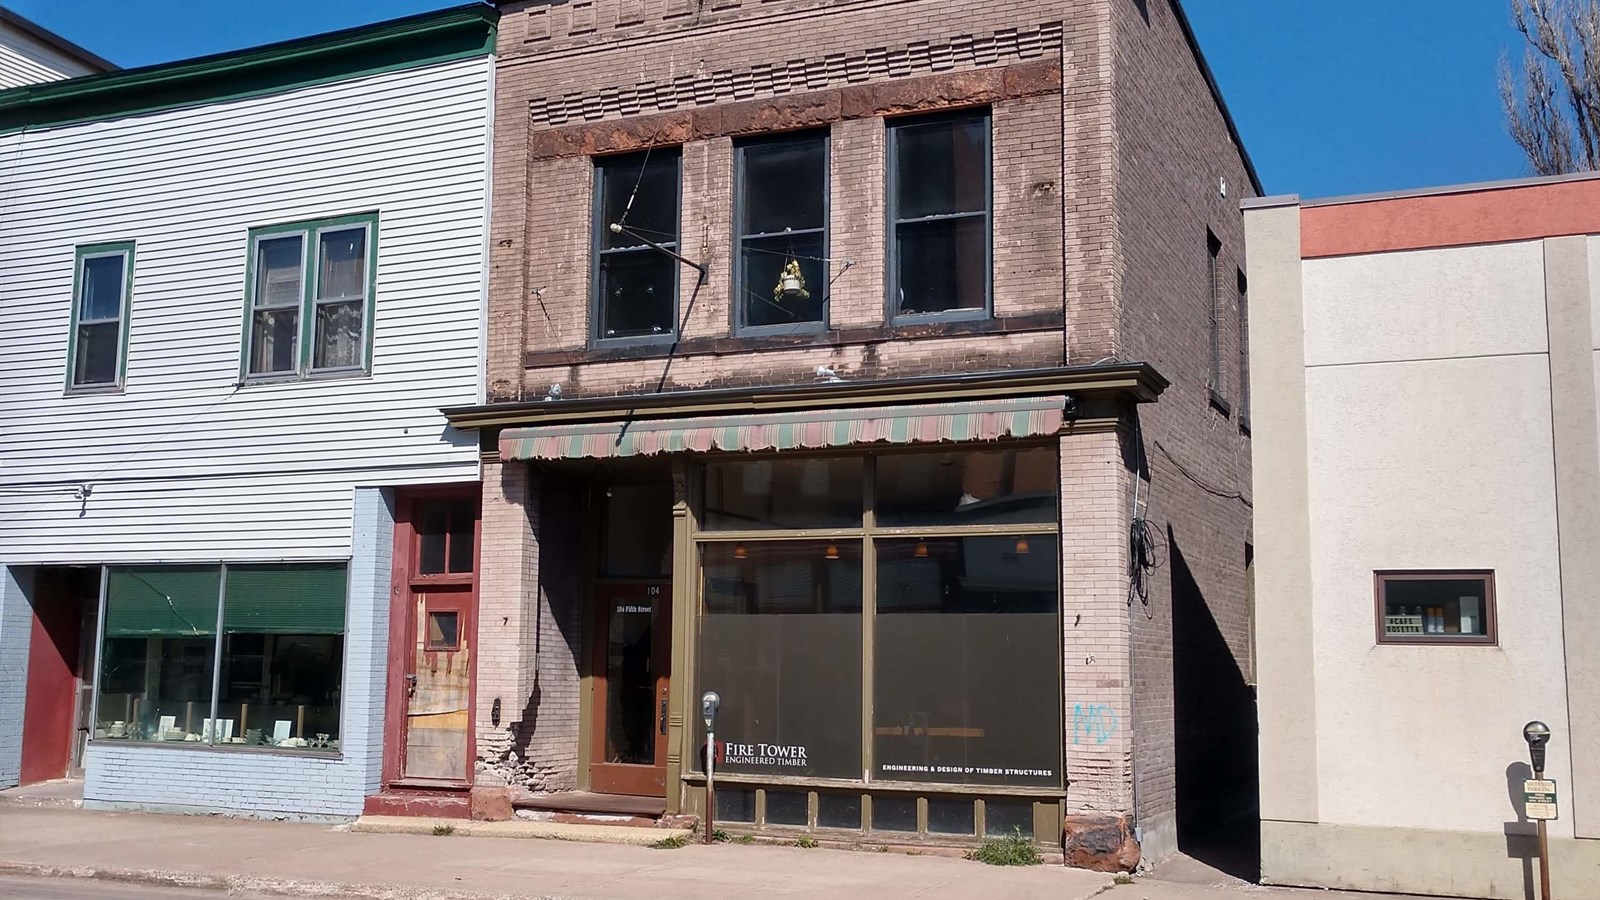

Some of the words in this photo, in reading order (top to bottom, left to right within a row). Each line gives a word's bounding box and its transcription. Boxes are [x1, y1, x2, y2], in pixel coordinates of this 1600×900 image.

[647, 586, 660, 595] 104
[625, 605, 637, 613] Fifth
[637, 605, 652, 613] Street
[725, 742, 754, 756] FIRE
[757, 743, 807, 759] TOWER
[725, 756, 775, 765] ENGINEERED
[777, 758, 807, 767] TIMBER
[882, 764, 929, 772] ENGINEERING
[975, 767, 1003, 775] TIMBER
[1004, 768, 1053, 776] STRUCTURES
